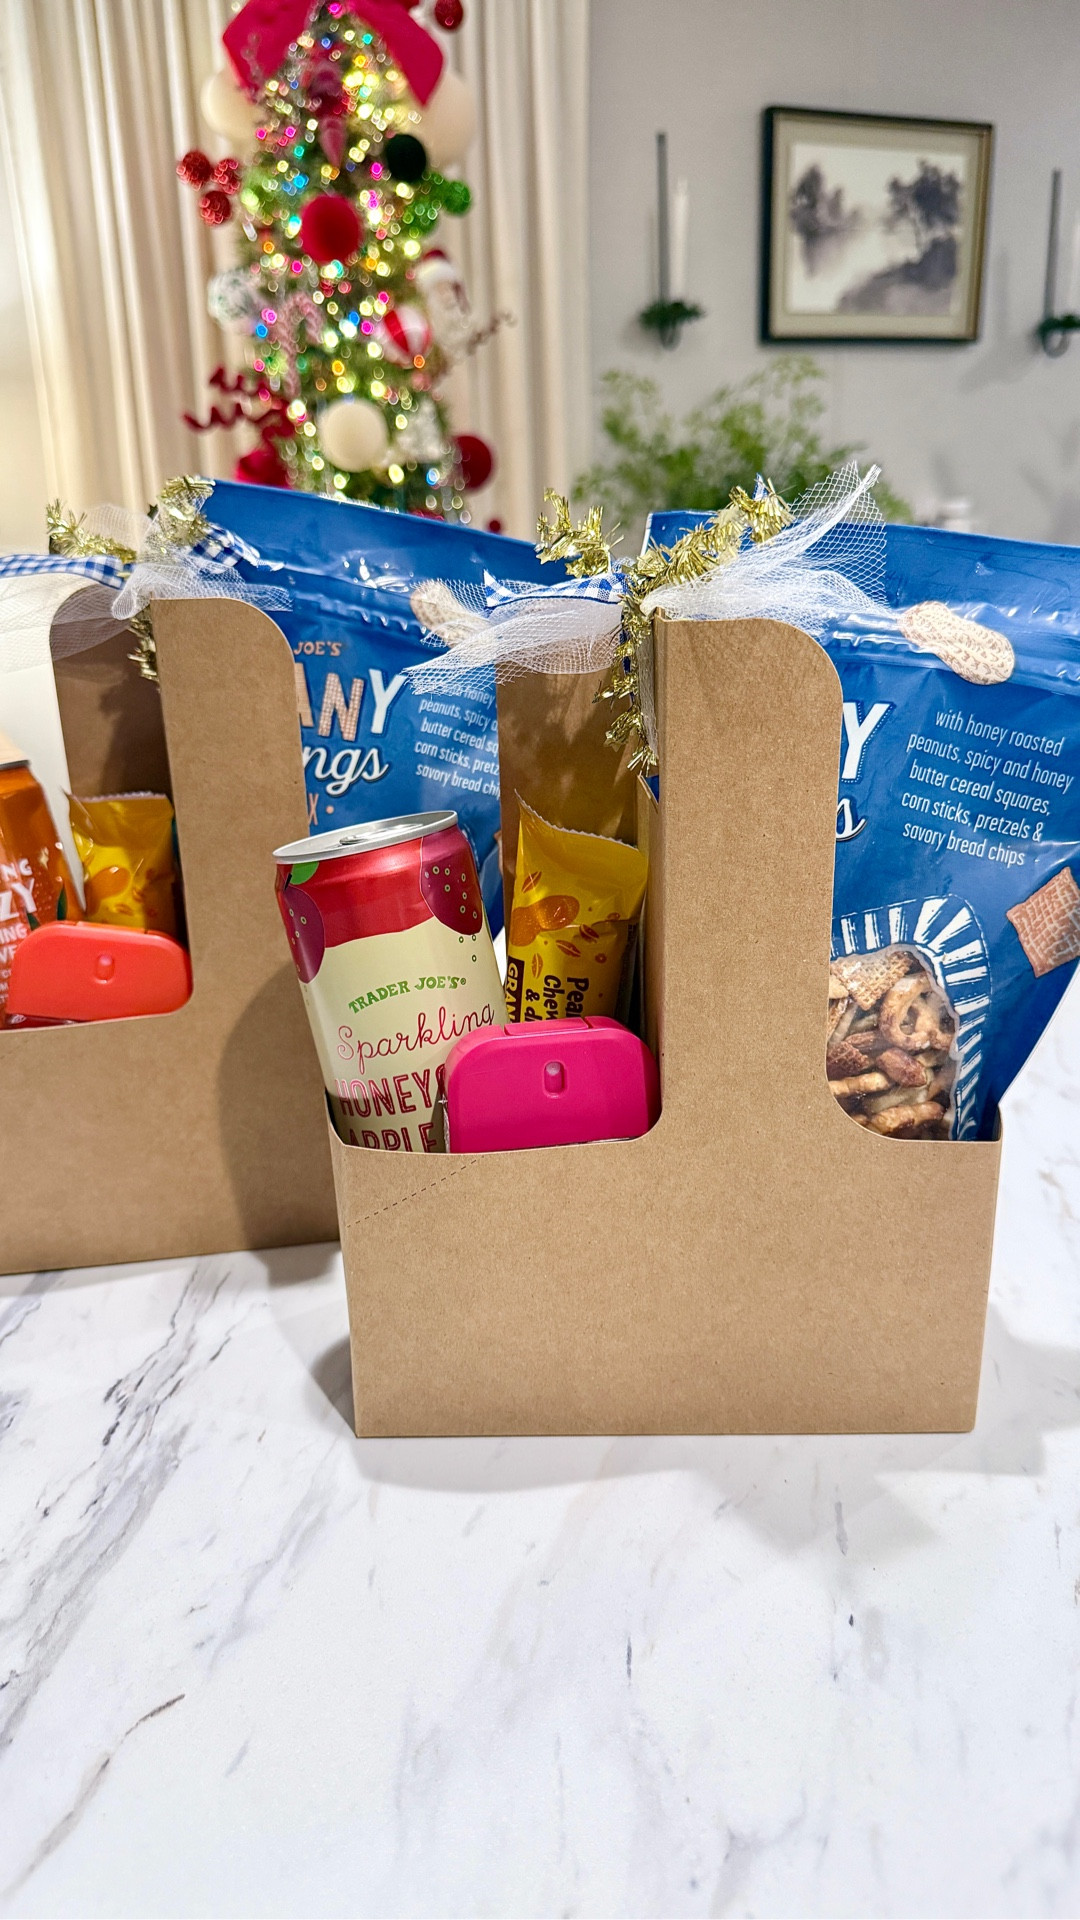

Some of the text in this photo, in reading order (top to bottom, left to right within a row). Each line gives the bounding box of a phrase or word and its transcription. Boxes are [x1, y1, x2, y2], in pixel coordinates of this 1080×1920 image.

[293, 641, 342, 657] JOE'S
[419, 698, 461, 720] peanuts,
[463, 709, 493, 732] spicy
[414, 741, 438, 758] corn
[421, 716, 453, 739] butter
[453, 730, 486, 750] cereal
[936, 710, 1065, 757] with honey roasted
[416, 764, 451, 787] savory
[451, 771, 483, 792] bread
[906, 733, 1074, 795] peanuts, spicy and honey
[909, 758, 1051, 817] butter cereal squares,
[901, 792, 1045, 843] corn sticks, pretzels &
[902, 822, 1026, 869] savory bread chips
[348, 980, 411, 1014] TRADER
[525, 988, 541, 1002] &
[337, 1003, 495, 1075] Sparkling
